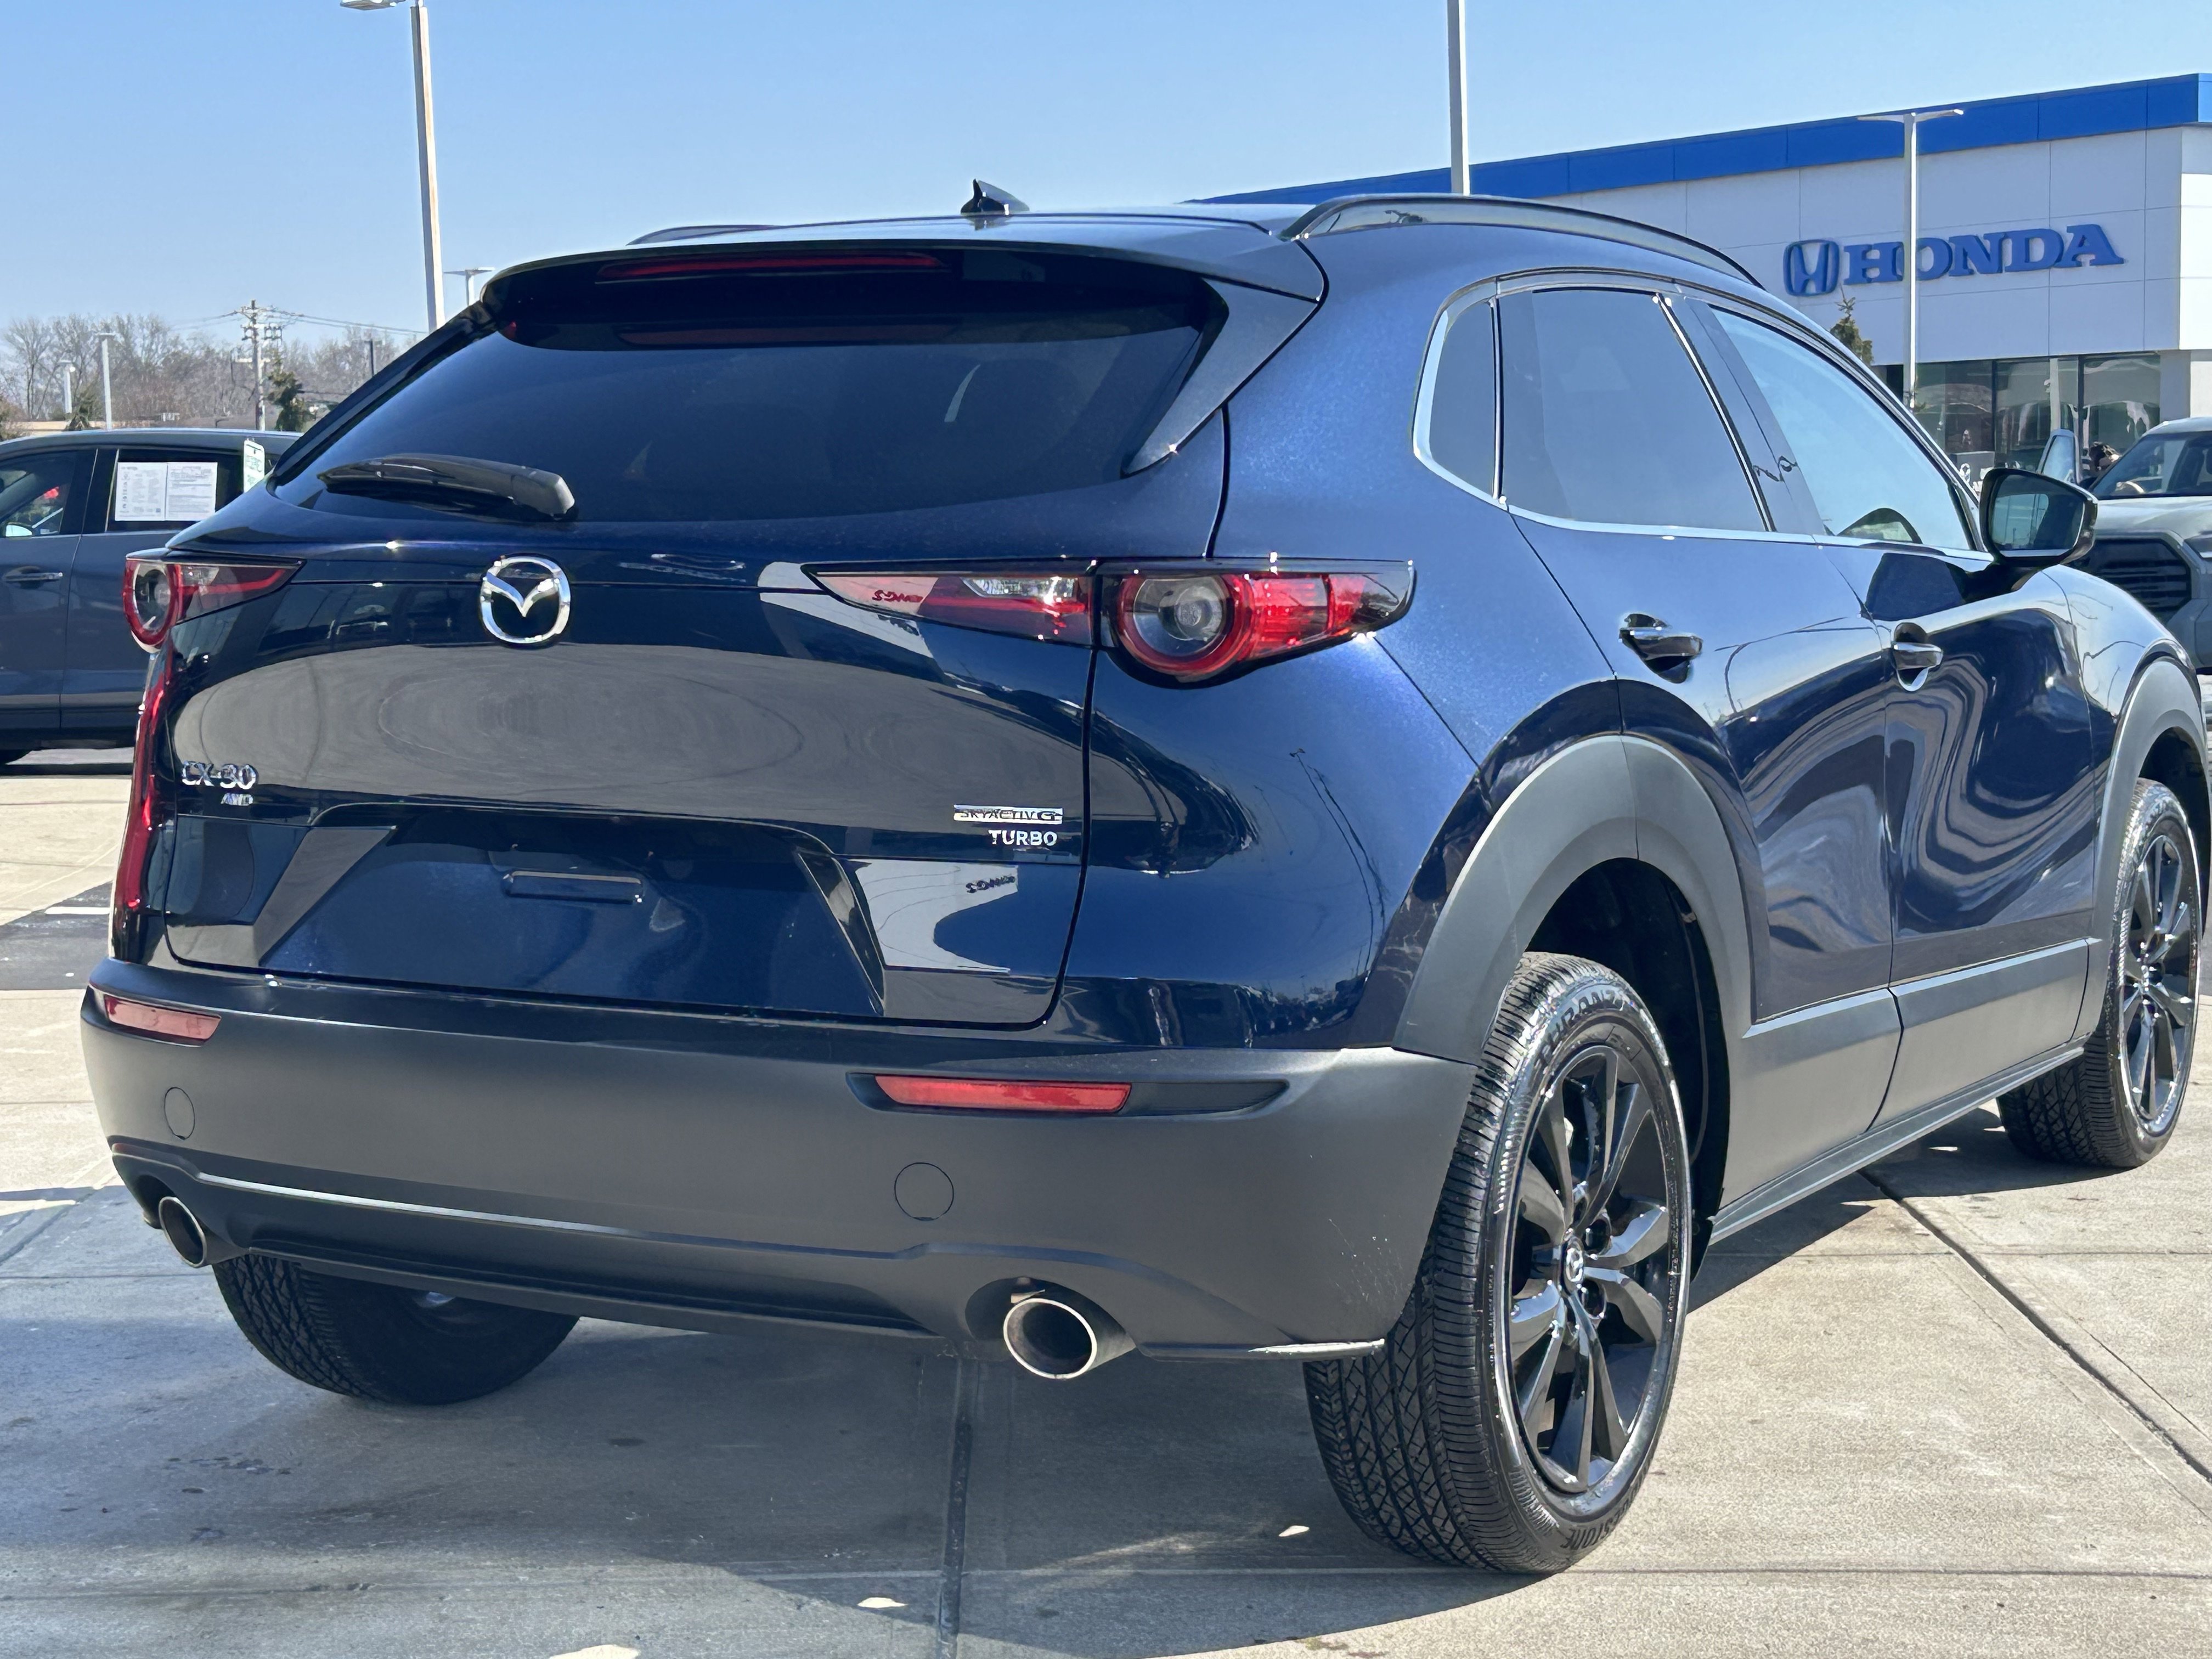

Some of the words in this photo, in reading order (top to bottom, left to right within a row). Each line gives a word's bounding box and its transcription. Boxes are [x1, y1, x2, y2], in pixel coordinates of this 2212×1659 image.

[1843, 224, 2125, 285] HONDA
[182, 760, 258, 790] CX-30
[988, 830, 1057, 847] TURBO
